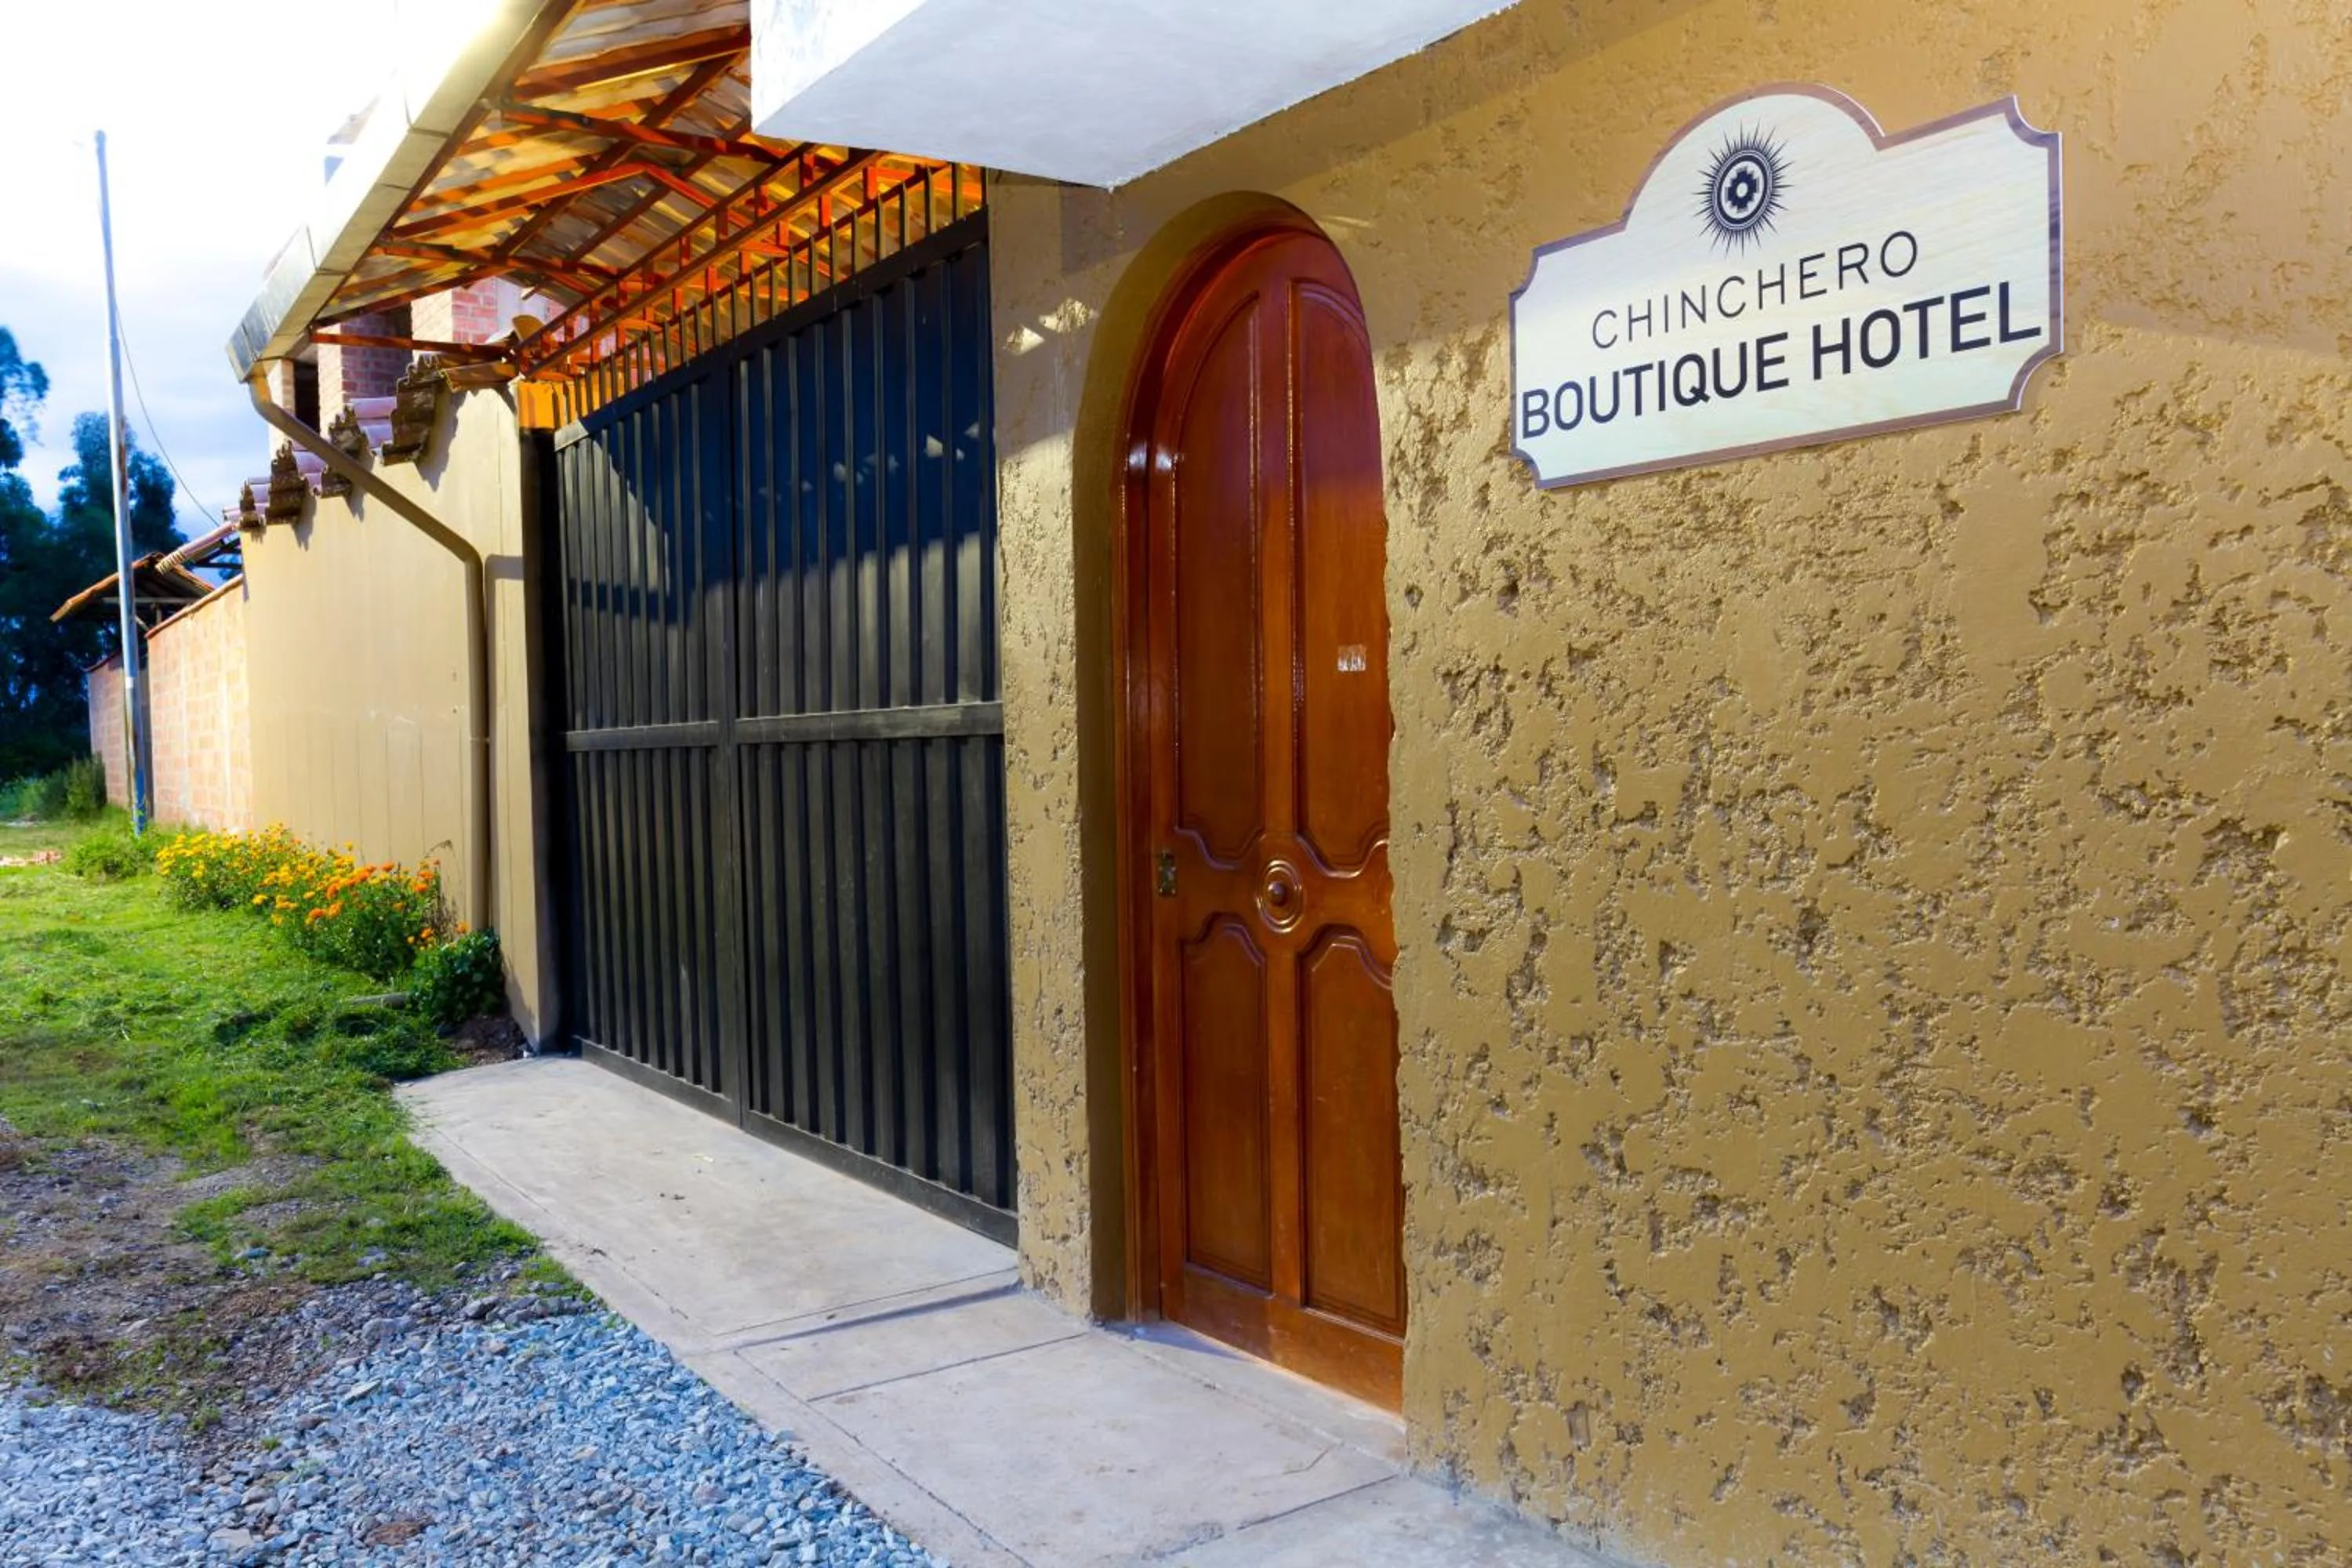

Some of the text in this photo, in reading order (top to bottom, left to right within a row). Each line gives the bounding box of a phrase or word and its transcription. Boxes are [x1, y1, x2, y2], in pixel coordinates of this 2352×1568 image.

[1521, 280, 2042, 440] BOUTIQUE HOTEL
[1592, 230, 1918, 350] CHINCHERO
